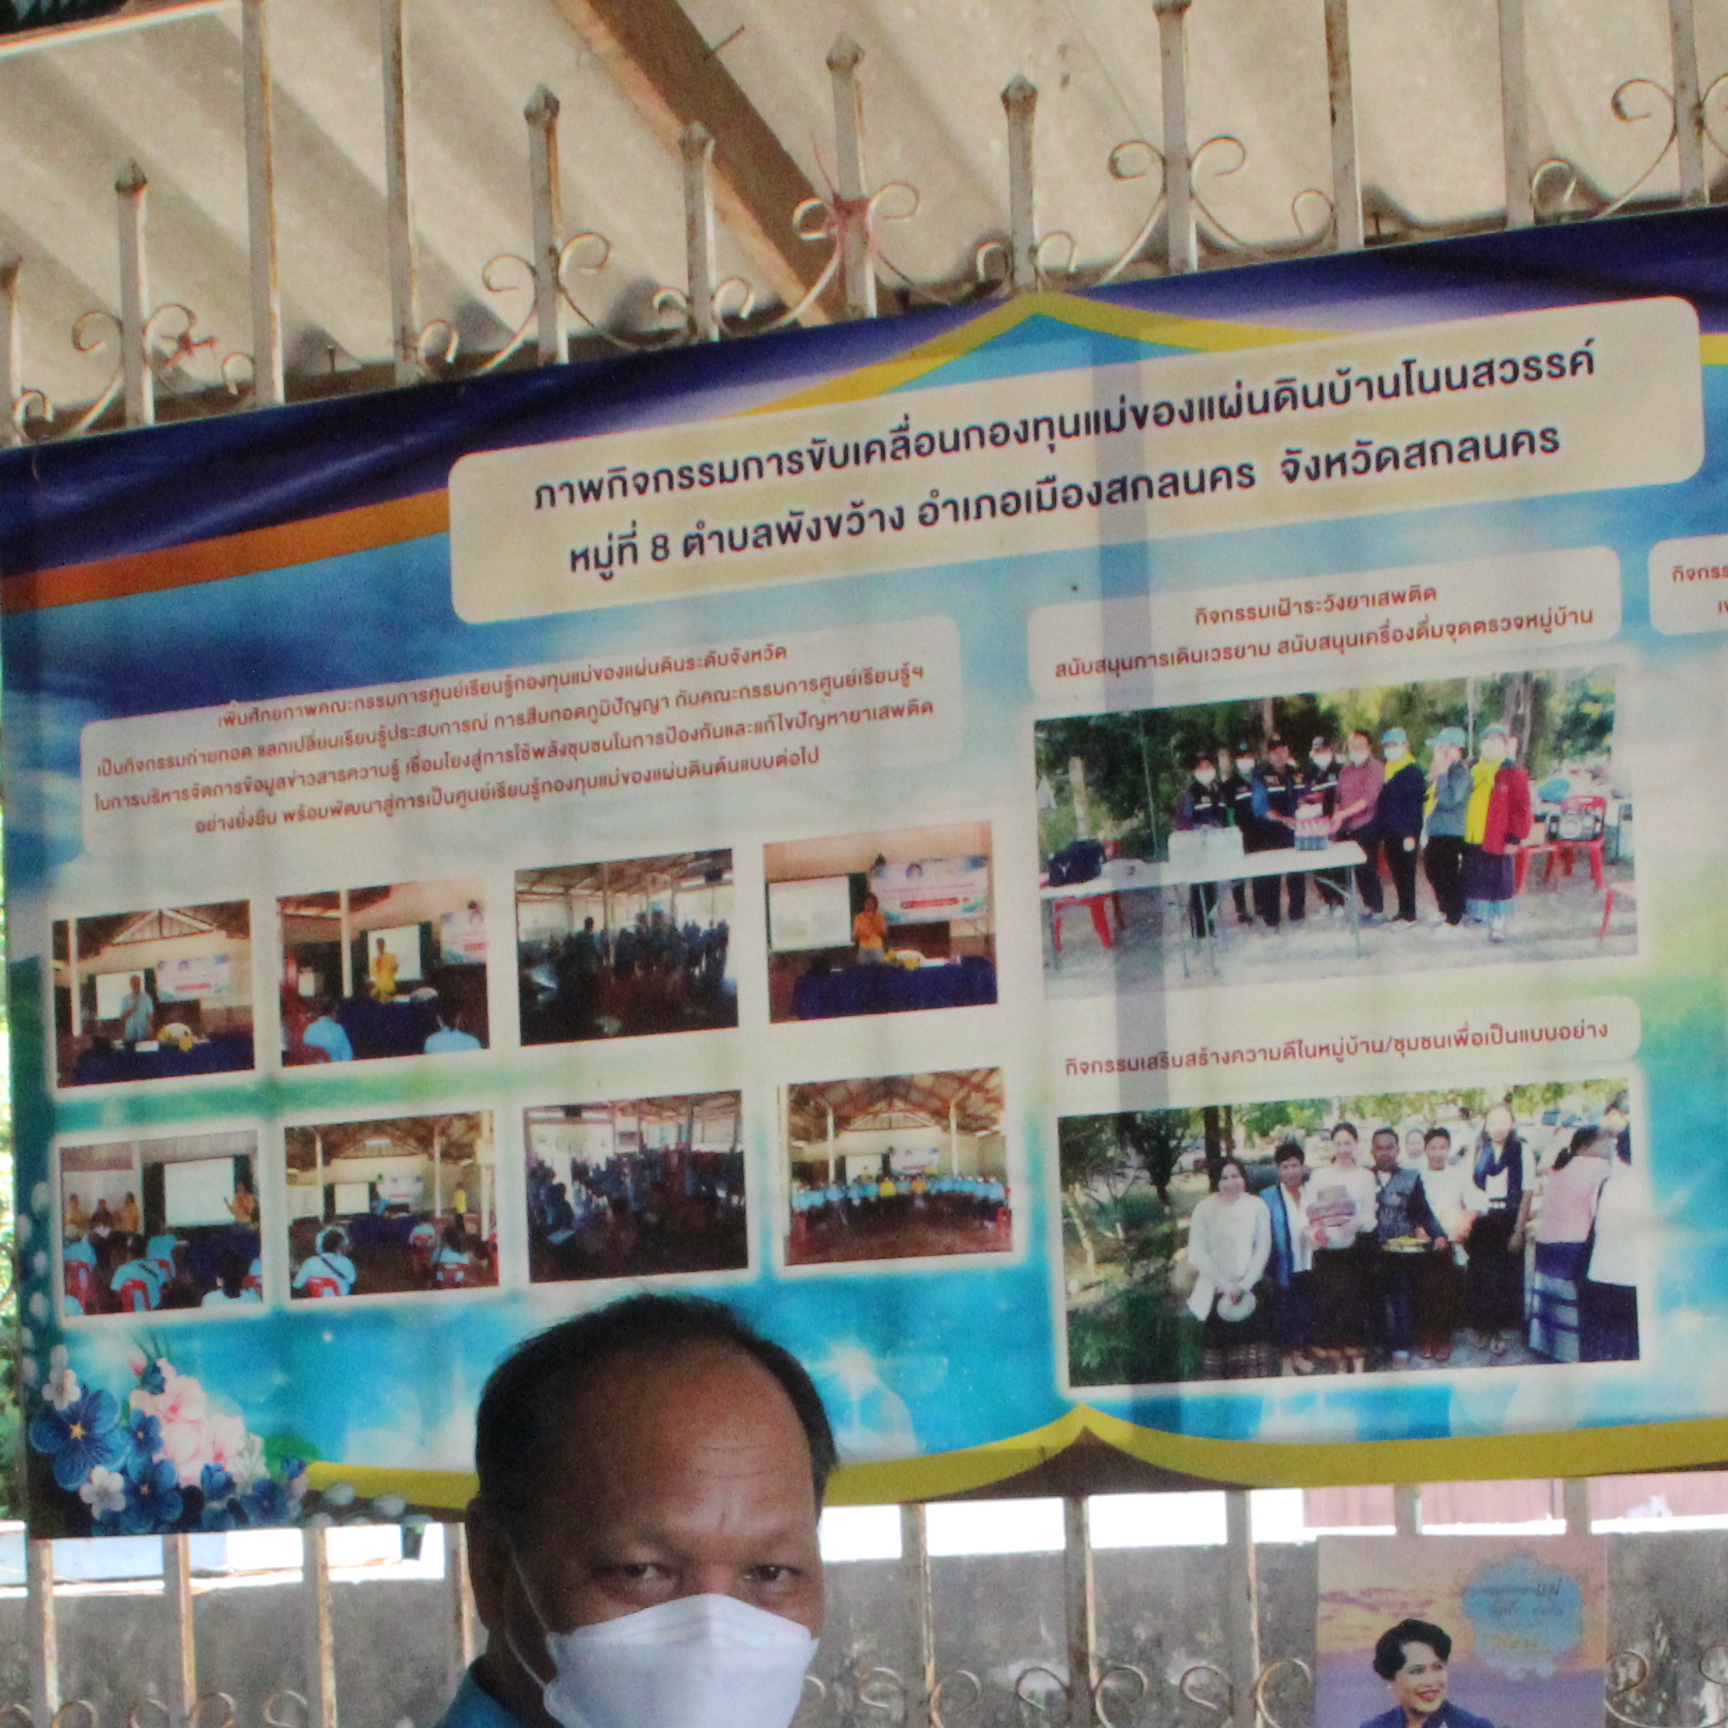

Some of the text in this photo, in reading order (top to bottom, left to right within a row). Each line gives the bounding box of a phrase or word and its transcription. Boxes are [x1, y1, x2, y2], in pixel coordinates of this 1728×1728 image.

[533, 340, 1595, 510] ภาพกิจกรรมการขับเคลื่อนกองทุนแม่ของแผ่นดินบ้านโนนสวรรค์
[569, 420, 1561, 578] หมู่ที่ 8 ตำบลพังขว้าง อำเภอเมืองสกลนคร จังหวัดสกลนคร
